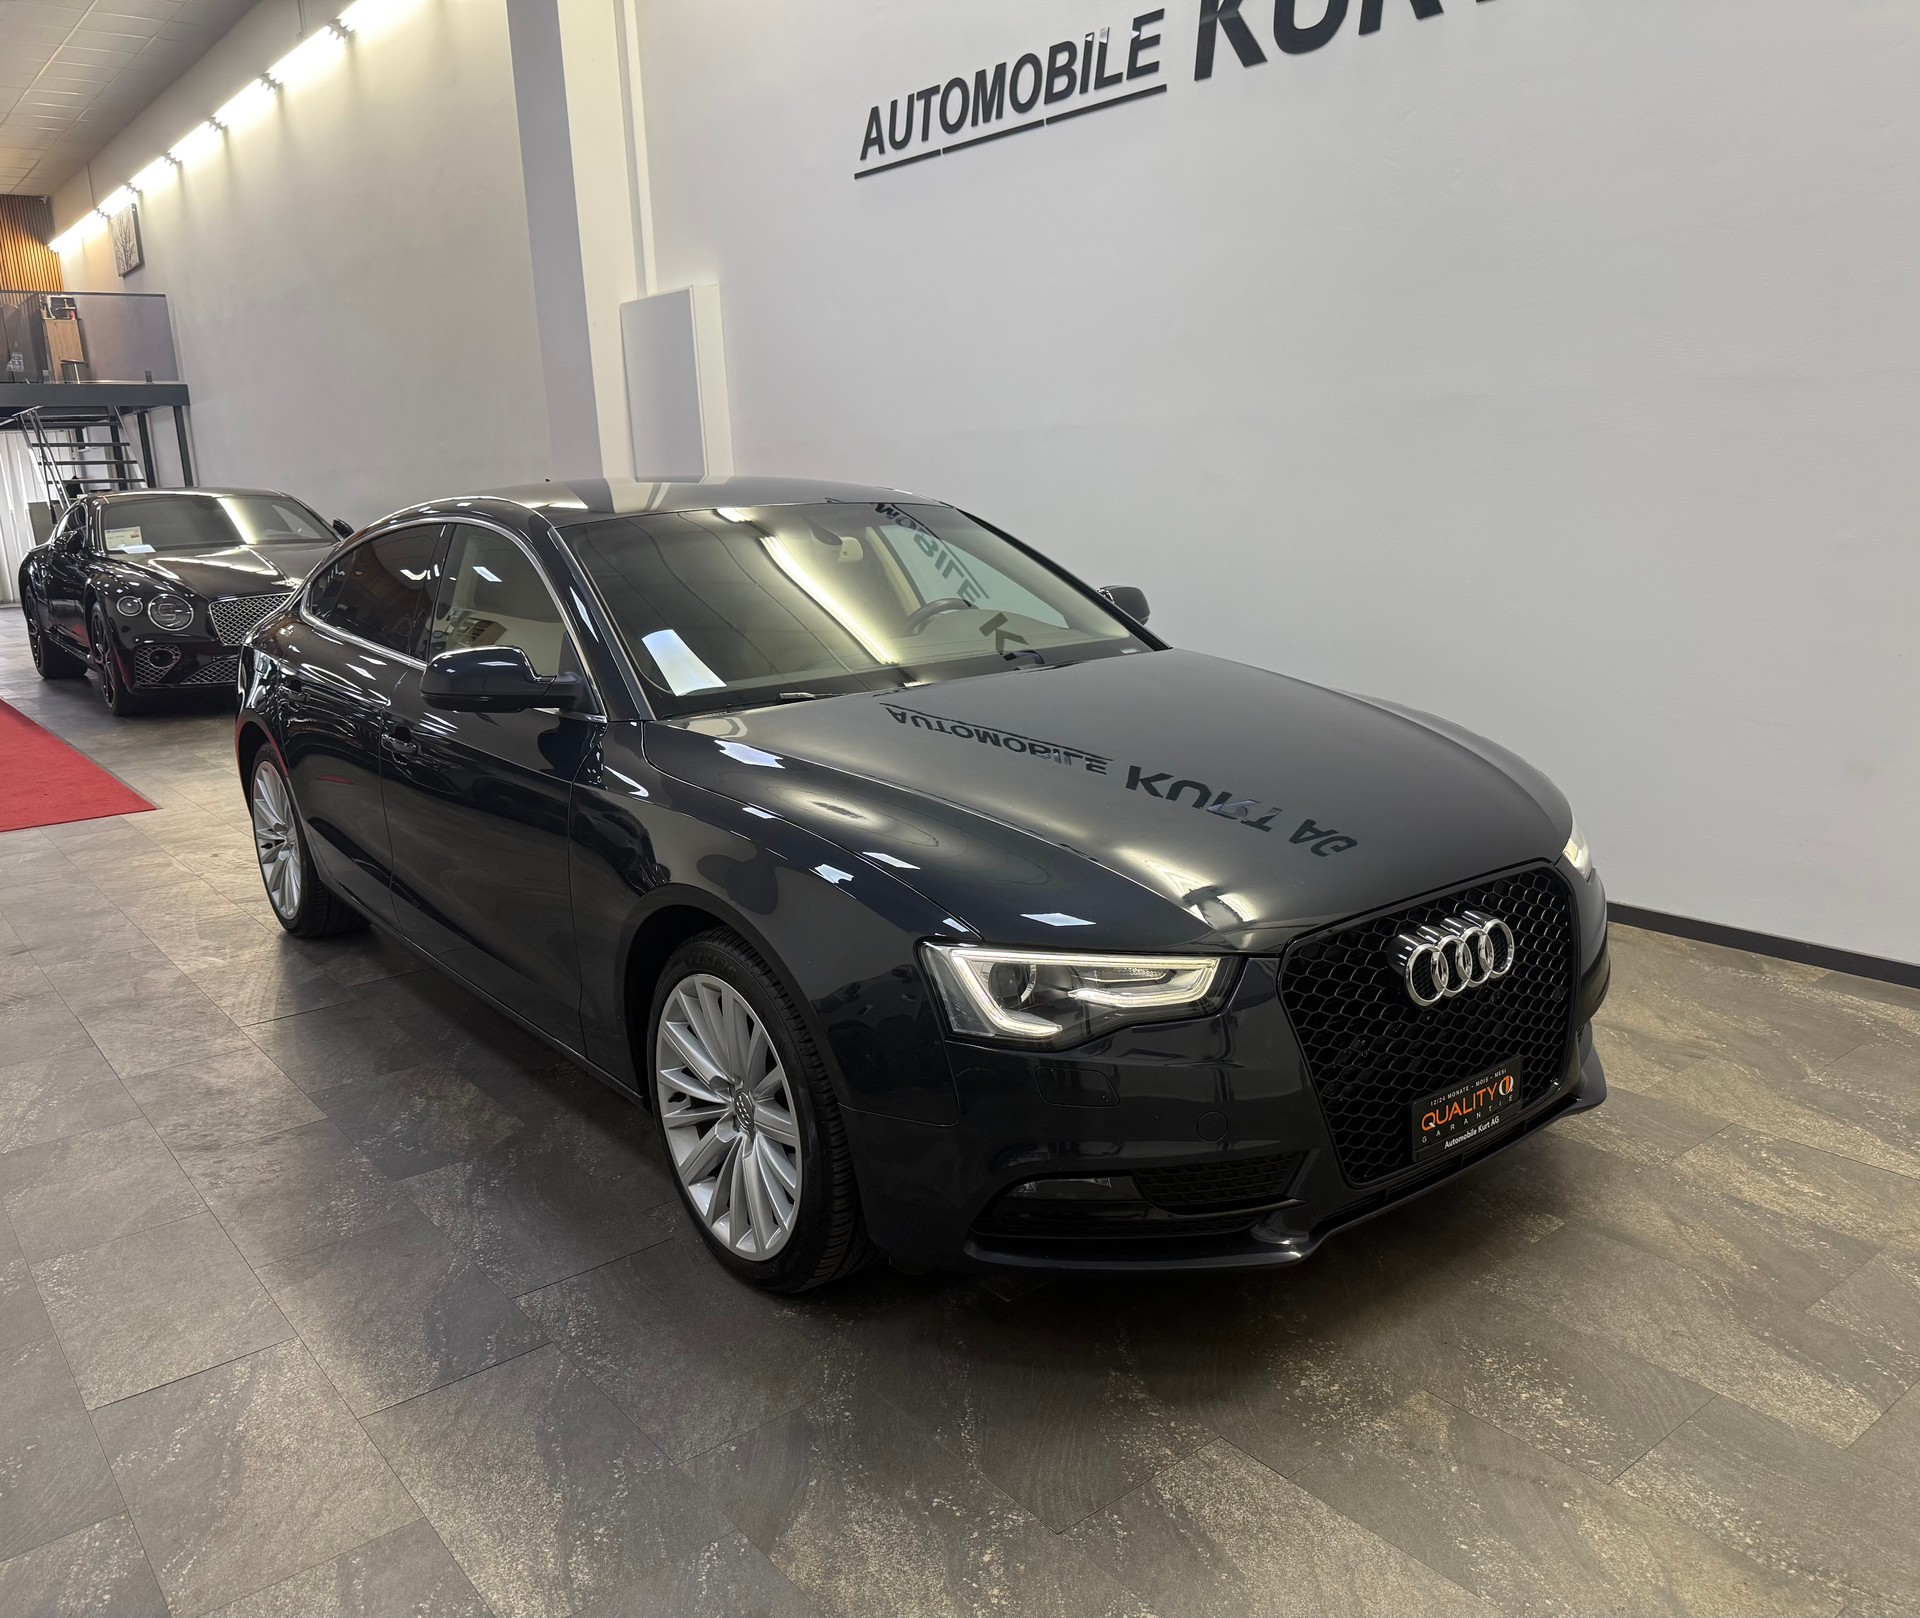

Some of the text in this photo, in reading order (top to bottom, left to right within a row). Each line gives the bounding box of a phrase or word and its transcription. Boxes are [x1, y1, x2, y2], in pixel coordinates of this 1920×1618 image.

[860, 8, 1165, 161] AUTOMOBILE
[1421, 1082, 1498, 1131] QUALITY
[1447, 1085, 1470, 1099] MONATE
[1475, 1077, 1489, 1087] MOIS
[1494, 1068, 1507, 1077] MESI
[1421, 1094, 1513, 1143] GARANTIE
[1444, 1115, 1500, 1149] Automobile Kurt AG
